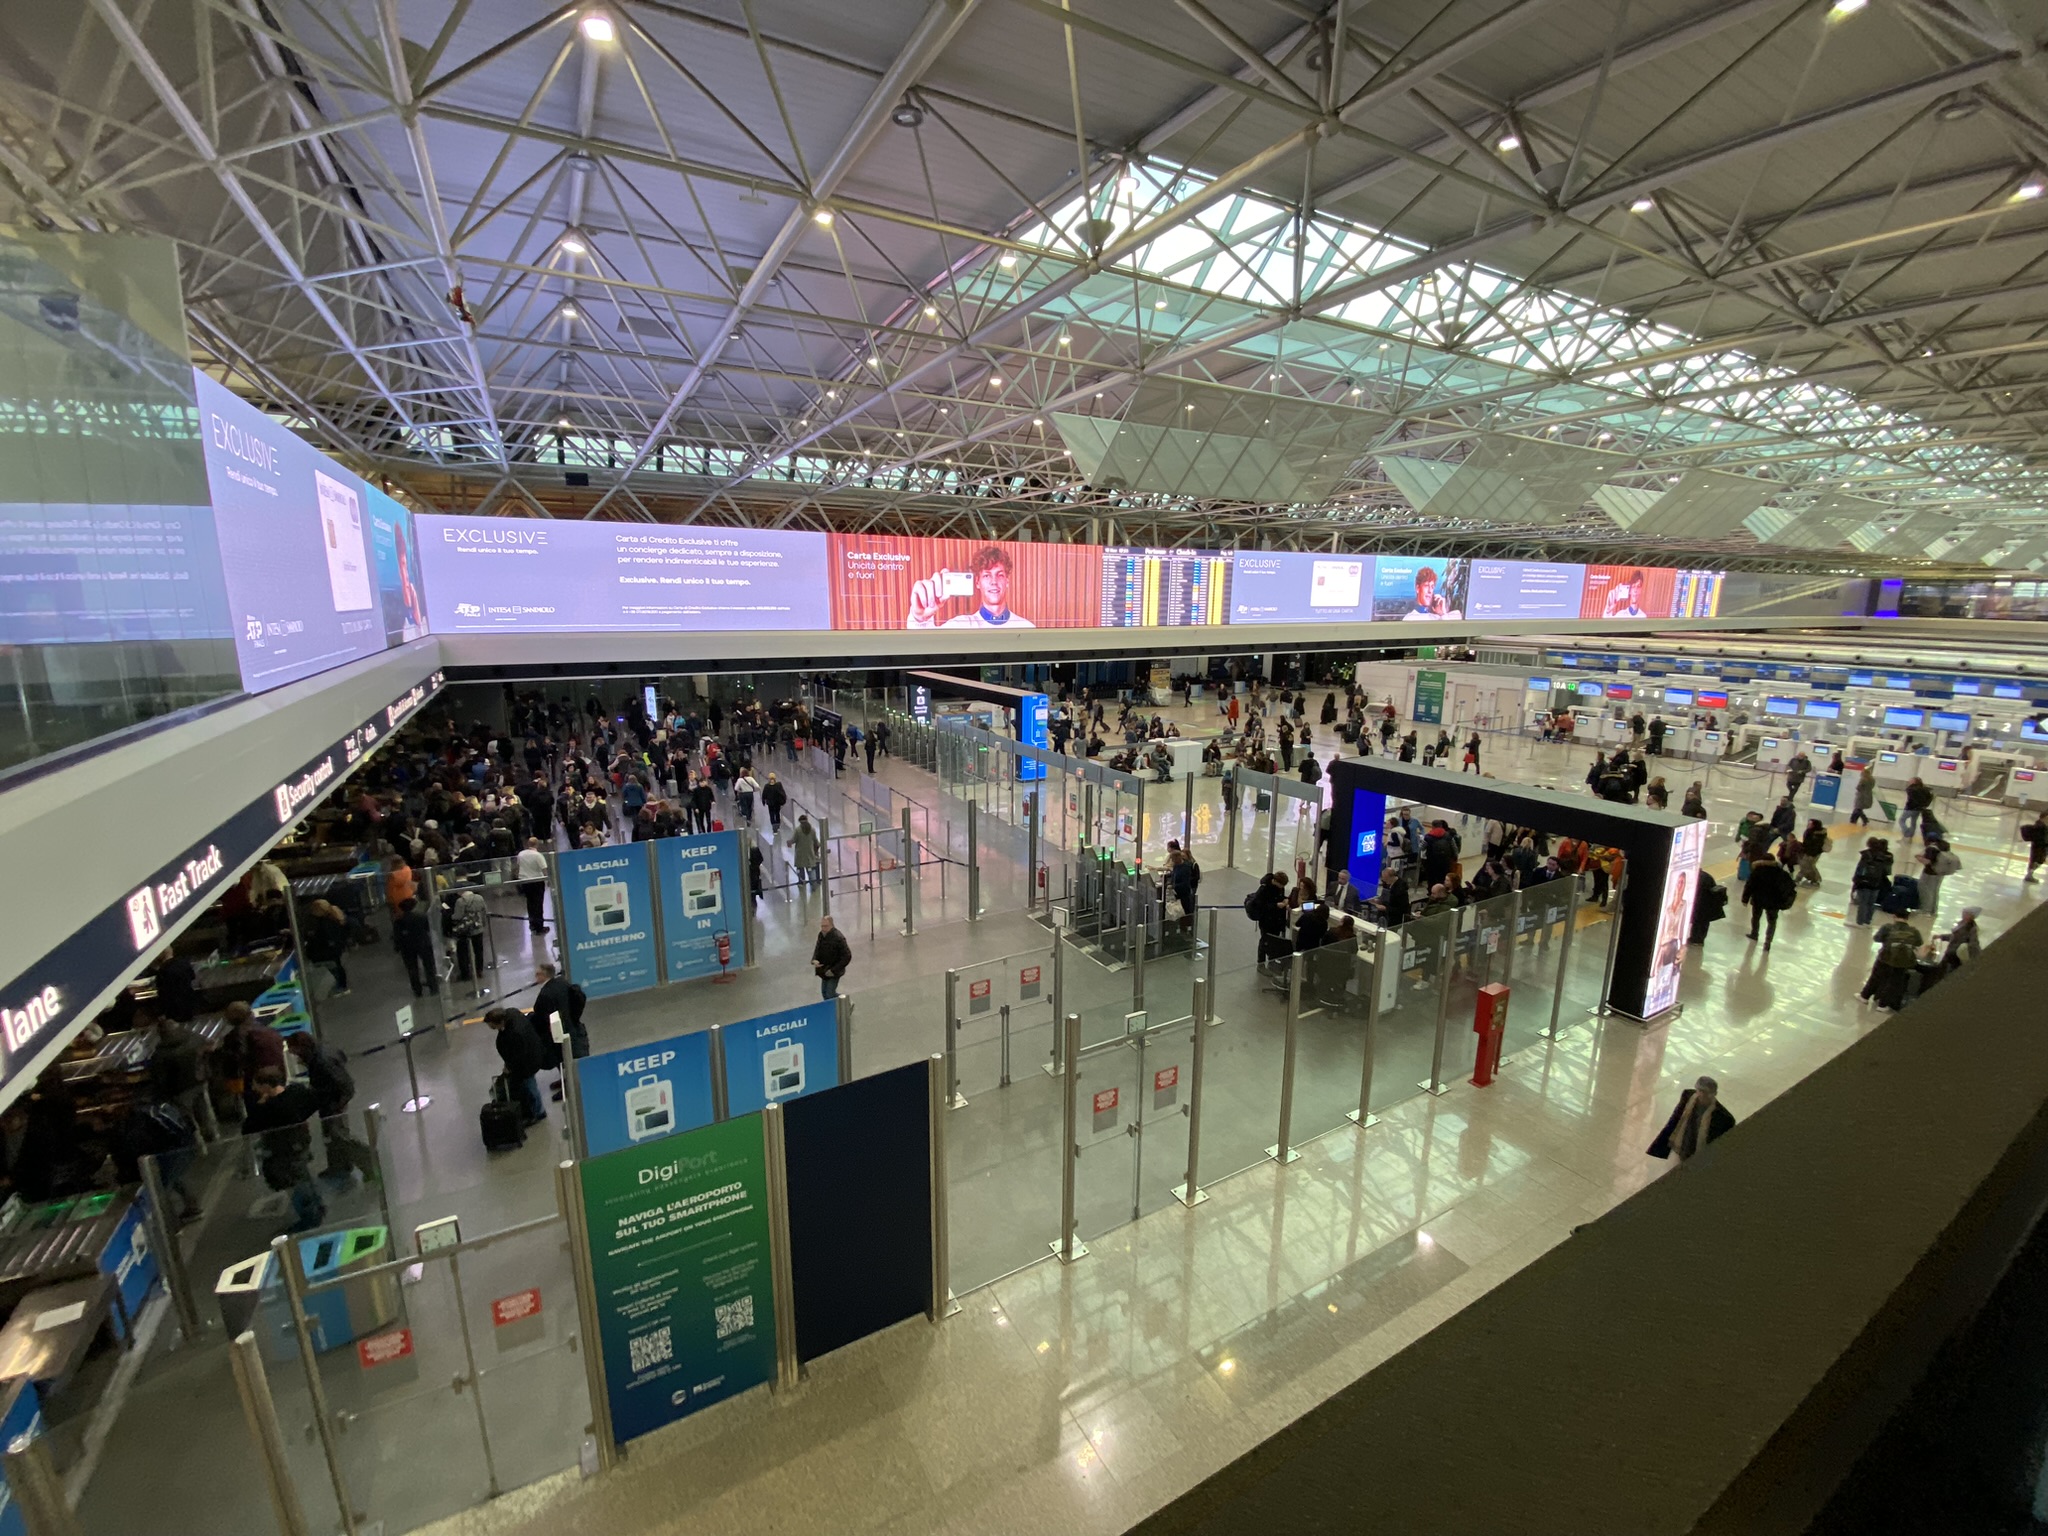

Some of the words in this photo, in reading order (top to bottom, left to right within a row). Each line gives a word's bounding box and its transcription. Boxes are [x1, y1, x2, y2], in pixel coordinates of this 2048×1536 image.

[211, 412, 281, 476] EXCLUSIVE
[443, 528, 548, 545] EXCLUSIVE
[615, 535, 639, 543] Carta
[648, 536, 678, 545] Credito
[679, 537, 713, 546] Exclusive
[720, 539, 739, 547] offre
[628, 546, 668, 556] concierge
[668, 547, 705, 556] dedicato,
[705, 549, 733, 557] sempre
[740, 549, 784, 559] disposizione,
[847, 551, 872, 560] Carta
[872, 552, 911, 561] Exclusive
[617, 557, 632, 565] per
[664, 556, 718, 566] indimenticabili
[740, 560, 780, 568] esperienze.
[848, 561, 876, 570] Unicità
[877, 562, 905, 571] dentro
[1239, 558, 1282, 569] EXCLUSIVE
[619, 576, 659, 584] Exclusive.
[660, 576, 682, 584] Rendi
[682, 577, 705, 585] unico
[705, 577, 710, 585] il
[725, 578, 752, 586] tempo.
[856, 571, 875, 579] fuori
[1553, 682, 1567, 690] 10A
[1638, 689, 1645, 697] 9
[1653, 690, 1660, 698] 8
[1735, 697, 1743, 706] 7
[1752, 699, 1760, 708] 6
[1848, 707, 1857, 716] 5
[1868, 709, 1877, 719] 4
[1979, 720, 1988, 730] 3
[2002, 722, 2012, 733] 2
[289, 774, 315, 804] Security
[681, 845, 718, 859] KEEP
[1362, 842, 1376, 853] EX
[578, 858, 629, 873] LASCIALI
[157, 883, 192, 917] Fast
[185, 844, 225, 891] Track
[697, 918, 712, 930] IN
[576, 931, 646, 951] ALL'INTERNO
[1, 985, 61, 1054] lane
[756, 1018, 808, 1039] LASCIALI
[617, 1050, 677, 1078] KEEP
[637, 1151, 719, 1186] DigiPort
[618, 1206, 665, 1228] NAVIGA
[666, 1181, 743, 1212] L'AEROPORTO
[615, 1227, 640, 1240] SUL
[641, 1216, 666, 1232] TUO
[668, 1190, 748, 1222] SMARTPHONE
[607, 1242, 641, 1257] NAVIGATE
[641, 1238, 654, 1246] THE
[655, 1227, 684, 1241] AIRPORT
[684, 1224, 694, 1232] ON
[695, 1217, 713, 1228] YOUR
